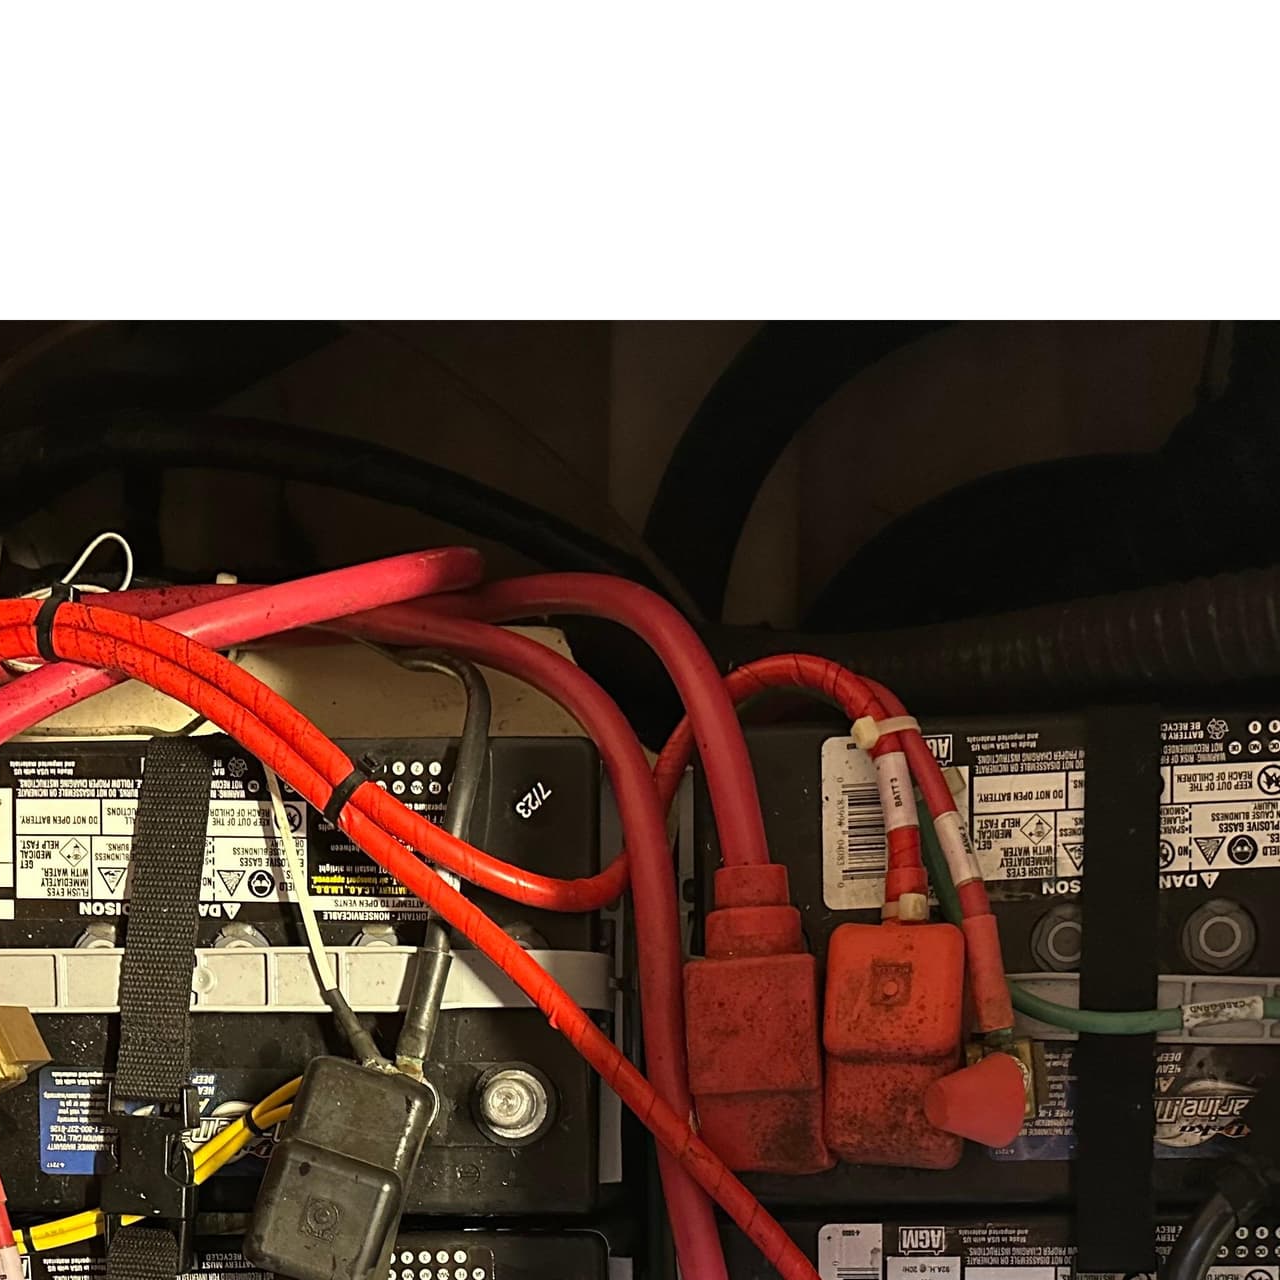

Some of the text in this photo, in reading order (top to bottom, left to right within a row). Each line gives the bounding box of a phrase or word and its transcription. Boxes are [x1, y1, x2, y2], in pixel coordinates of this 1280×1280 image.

[1229, 771, 1252, 780] REACH
[1189, 781, 1252, 791] KEEP OUT THE
[514, 781, 552, 819] 7/23
[891, 784, 902, 807] BATT
[977, 790, 1050, 803] NOT OPEN BATTERY.
[20, 815, 97, 824] DO NOT OPEN BATTERY.
[1211, 811, 1274, 821] CAUSE BLINDNESS
[240, 818, 252, 826] OUT
[977, 819, 1020, 828] HELP FAST.
[1219, 823, 1244, 833] GASES
[977, 830, 1011, 839] MEDICAL
[20, 840, 59, 849] HELP FAST.
[20, 850, 51, 859] MEDICAL
[1001, 846, 1052, 857] WITH WATER.
[20, 860, 33, 868] GET
[240, 858, 262, 867] GASES
[1000, 857, 1052, 867] IMMEDIATELY
[41, 868, 89, 877] WITH WATER.
[1006, 868, 1052, 877] FLUSH EYES
[41, 878, 89, 887] IMMEDIATELY
[47, 888, 89, 896] FLUSH EYES
[323, 912, 389, 920] NONSERVICEABLE
[1182, 1098, 1249, 1122] arine
[902, 1229, 942, 1249] AGM
